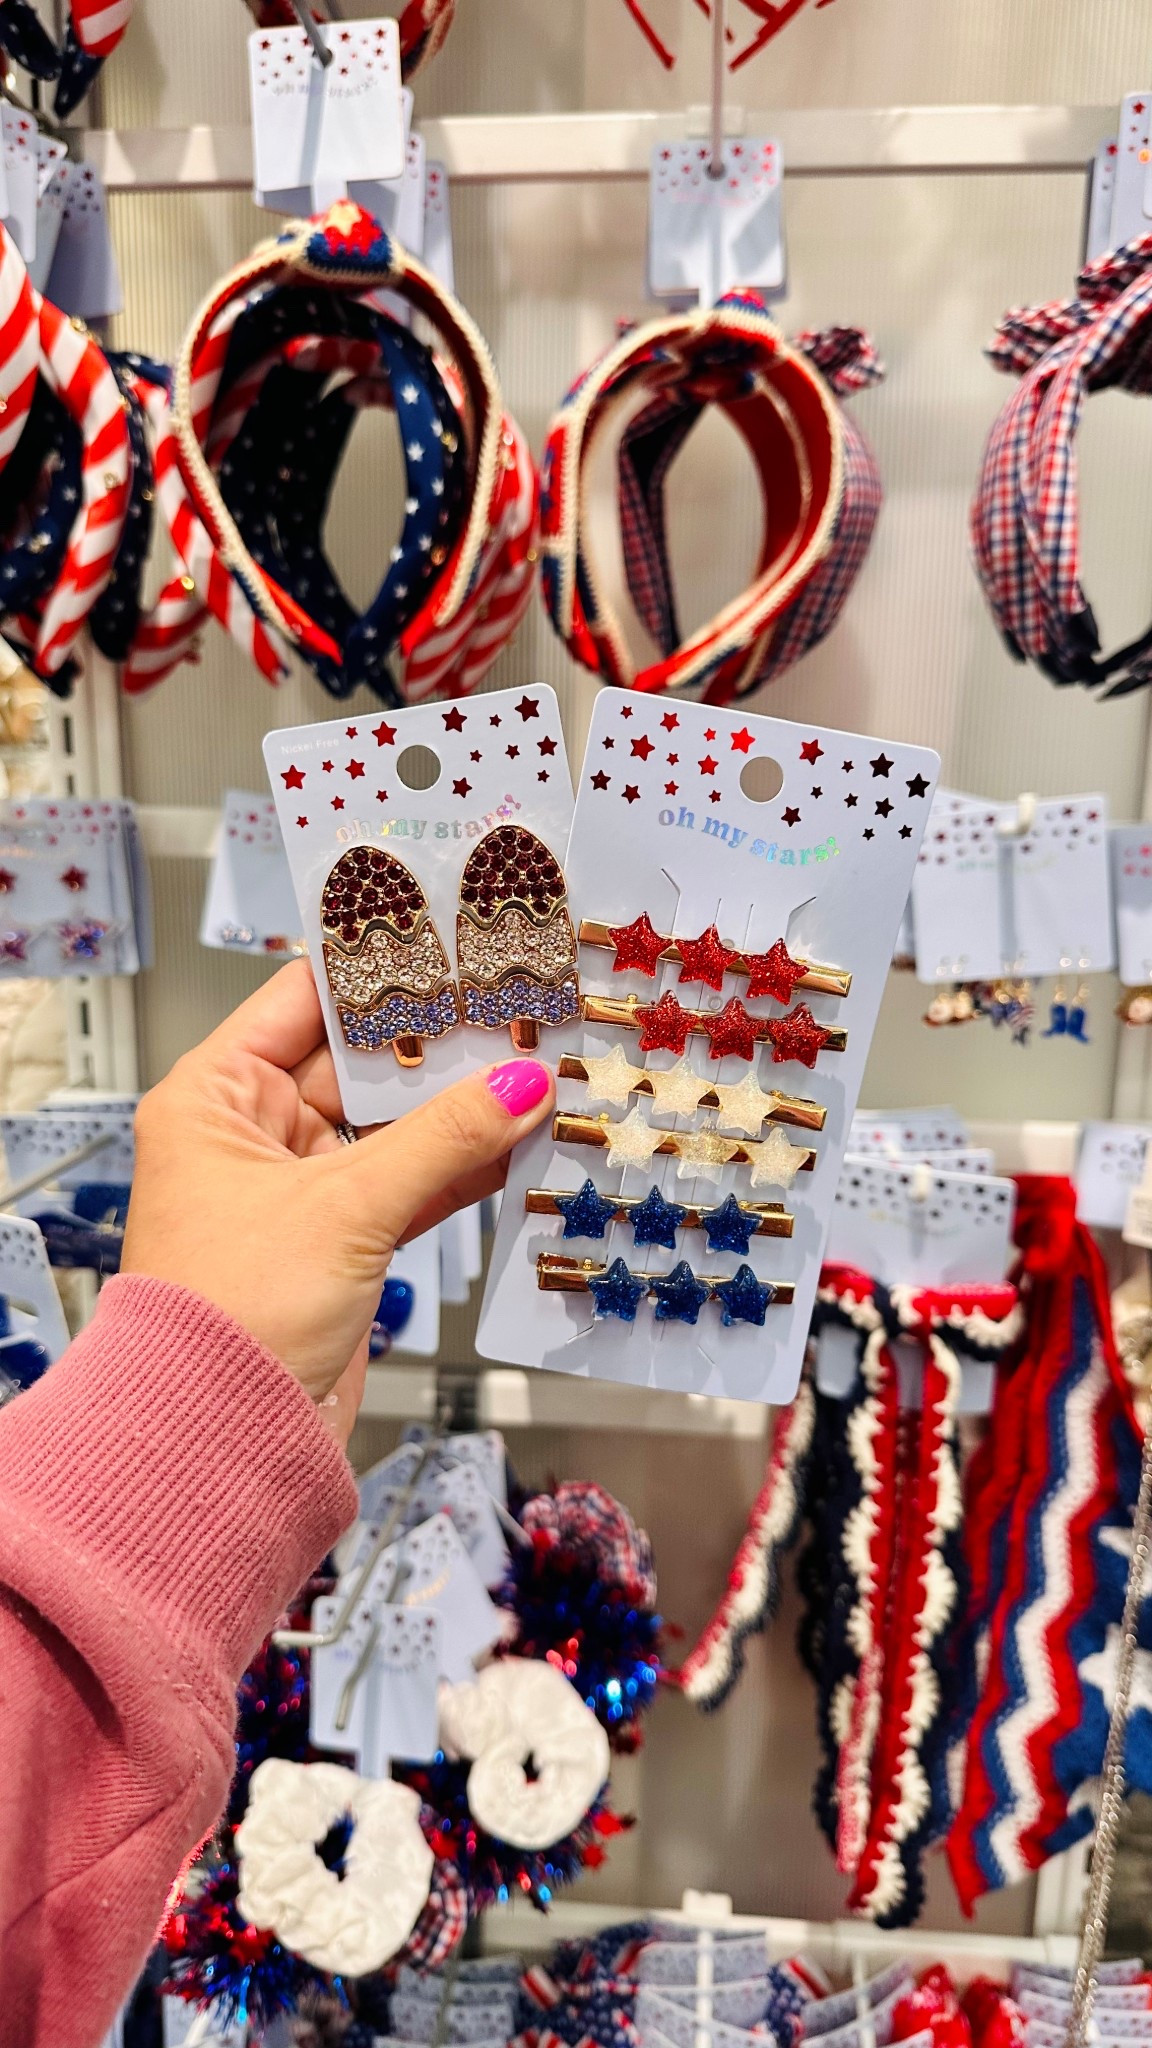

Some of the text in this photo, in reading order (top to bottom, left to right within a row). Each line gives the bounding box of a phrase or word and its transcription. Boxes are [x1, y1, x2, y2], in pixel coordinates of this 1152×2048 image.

[336, 818, 372, 844] oh
[380, 818, 428, 840] my
[658, 806, 841, 866] oh my stars!
